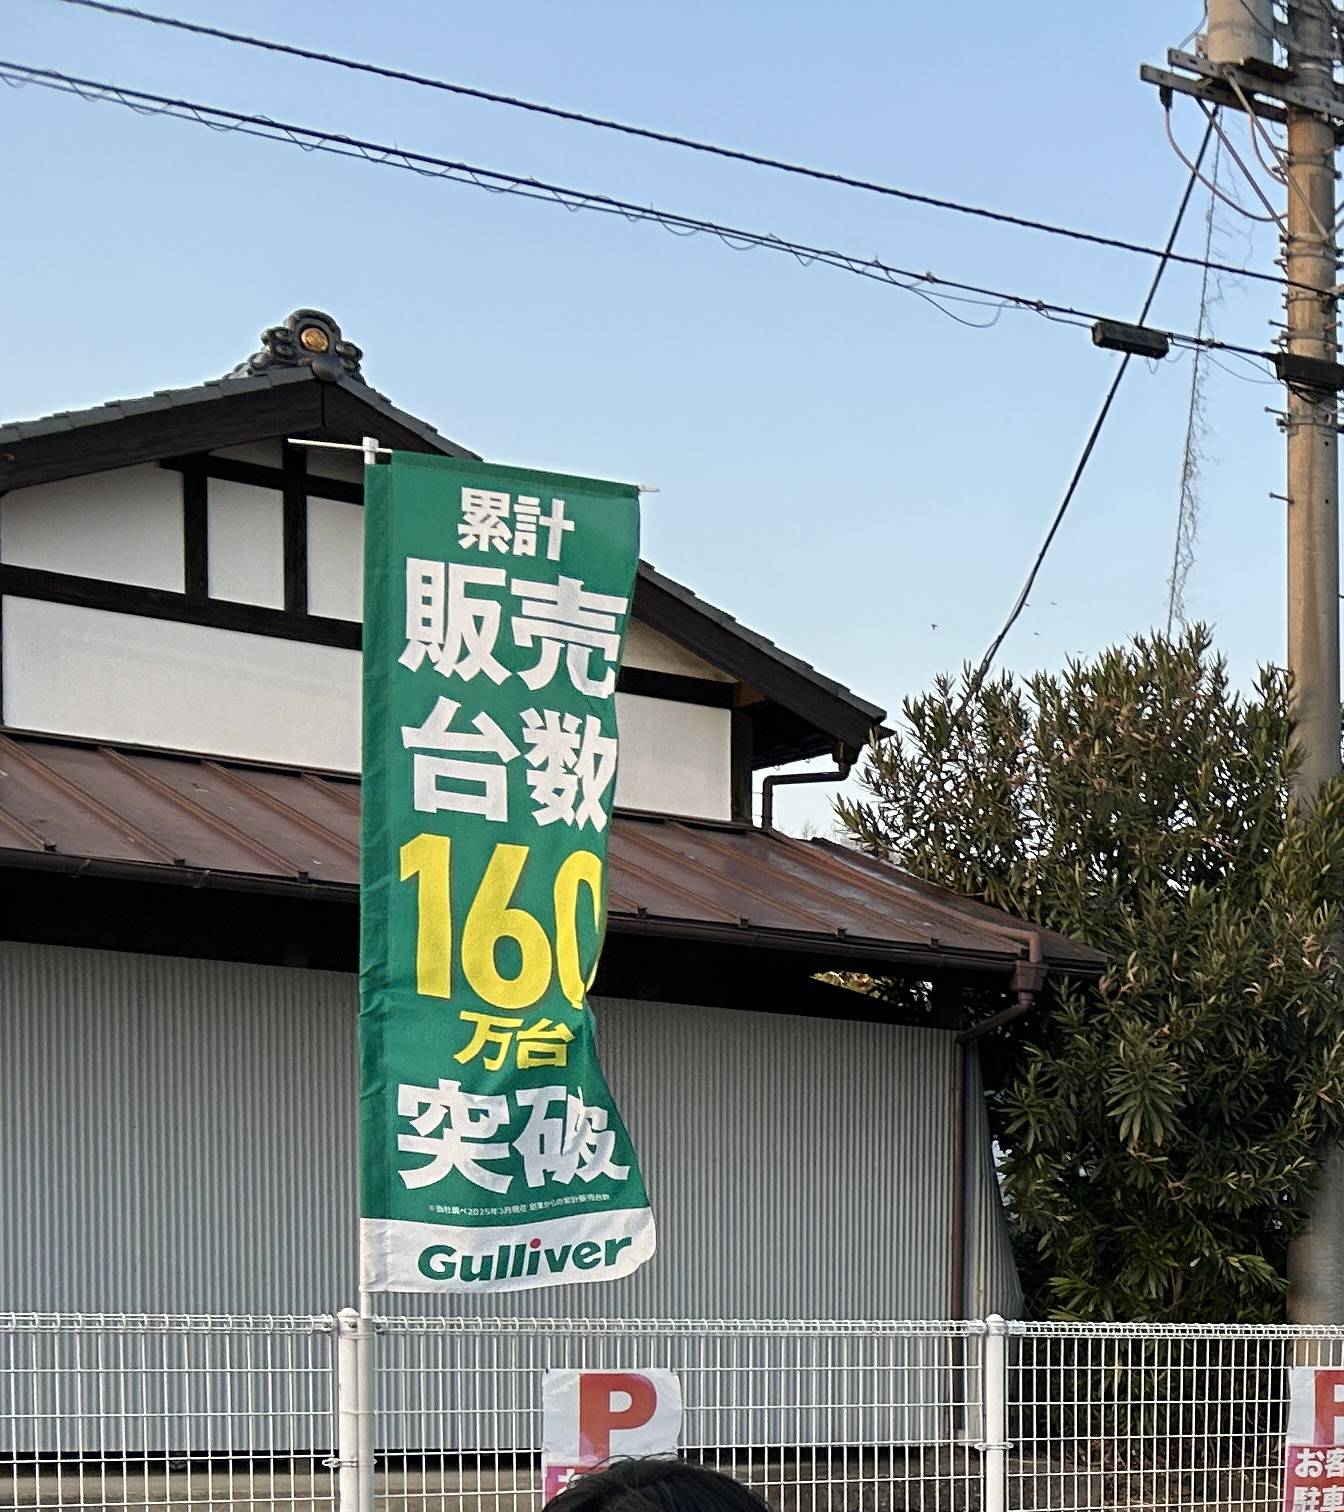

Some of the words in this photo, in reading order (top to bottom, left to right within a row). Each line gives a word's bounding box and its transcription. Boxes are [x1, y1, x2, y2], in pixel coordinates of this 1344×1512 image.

[457, 487, 576, 561] 累計
[398, 557, 629, 701] 販売
[400, 696, 620, 834] 台数
[400, 833, 603, 1010] 160
[453, 1010, 576, 1071] 万台
[397, 1078, 630, 1195] 突破
[418, 1237, 633, 1282] Gulliver
[579, 1372, 657, 1463] P
